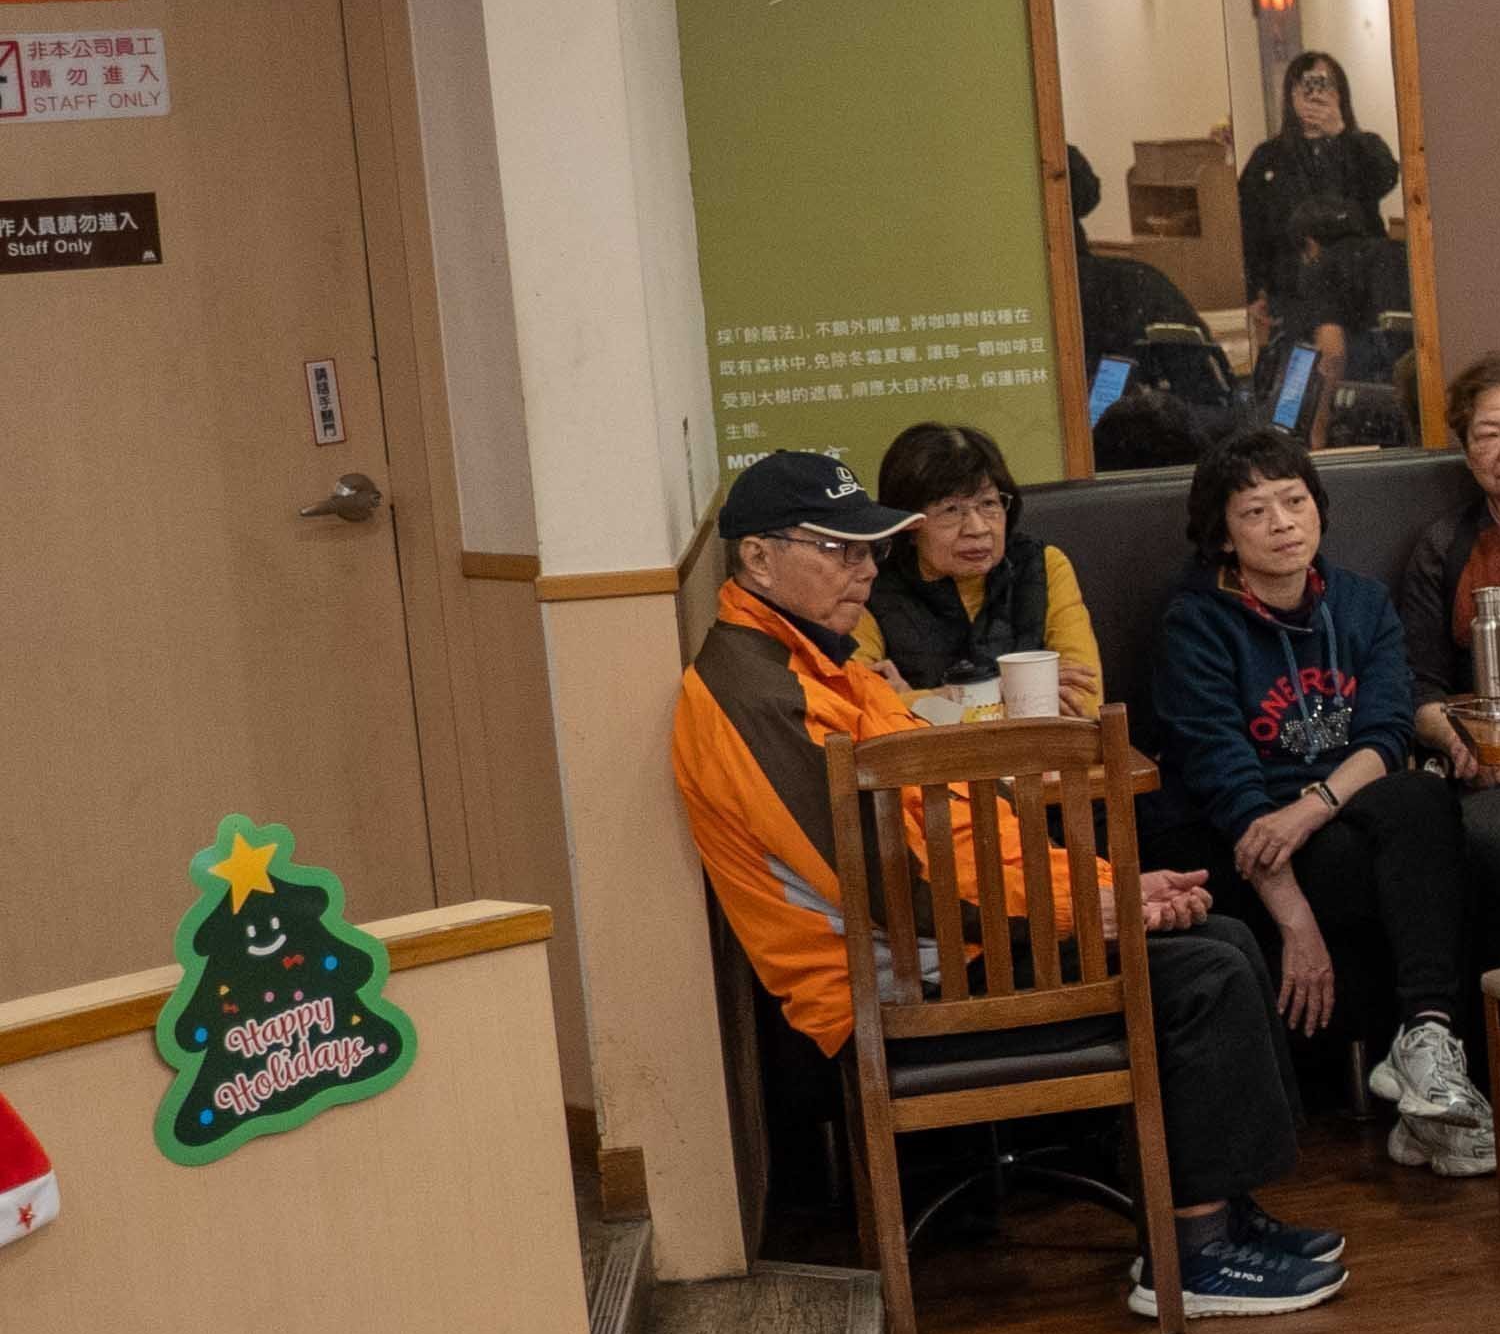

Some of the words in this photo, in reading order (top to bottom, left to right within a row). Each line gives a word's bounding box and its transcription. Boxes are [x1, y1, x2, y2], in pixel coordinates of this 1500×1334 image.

[28, 37, 157, 60] 非本公司員工
[30, 65, 160, 89] 請勿進入
[33, 94, 97, 113] STAFF
[109, 91, 162, 110] ONLY
[8, 239, 51, 257] Staff
[54, 239, 93, 255] Only
[225, 996, 335, 1059] Happy
[214, 1034, 375, 1115] Holidays
